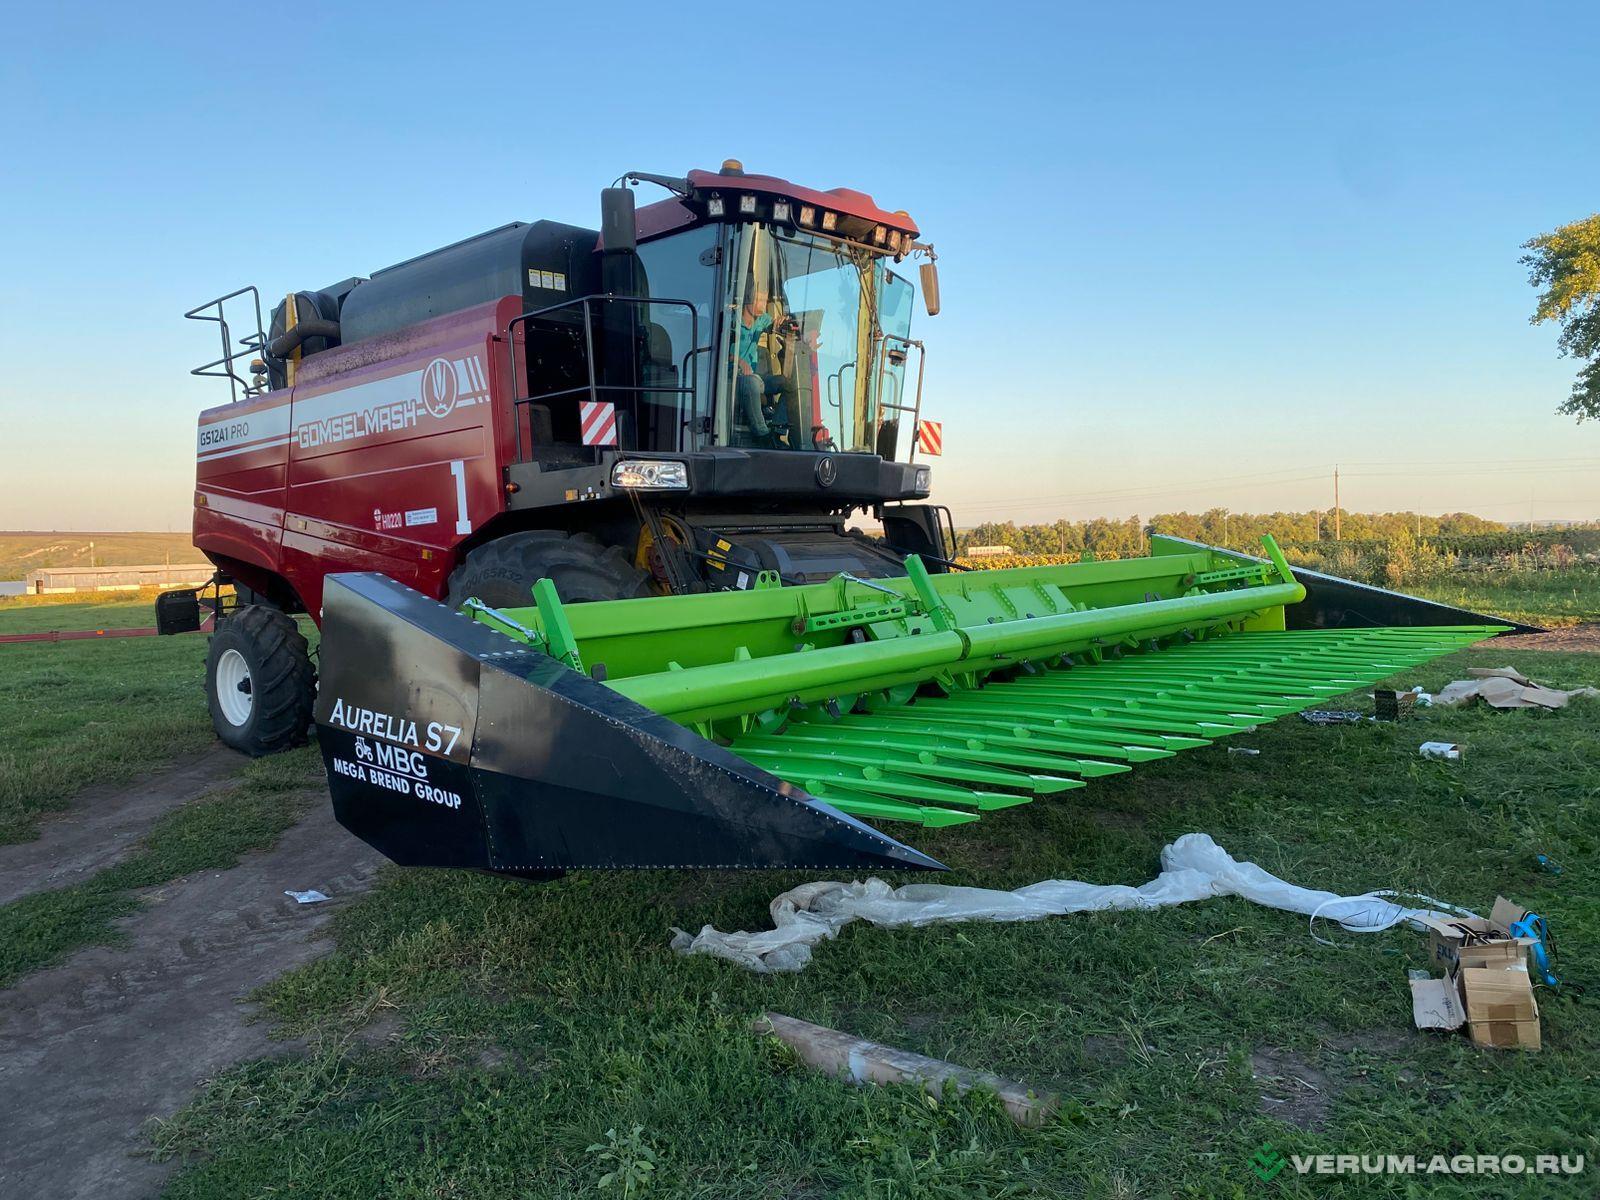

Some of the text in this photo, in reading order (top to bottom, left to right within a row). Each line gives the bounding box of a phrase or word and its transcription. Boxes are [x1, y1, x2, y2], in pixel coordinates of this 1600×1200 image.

[200, 421, 249, 446] GS12A1 PRO
[298, 399, 417, 449] GOMSELMASH
[450, 460, 472, 535] 1
[329, 698, 461, 756] AURELIA S7
[333, 757, 462, 810] MEGA BREND GROUP
[375, 741, 428, 778] MBG
